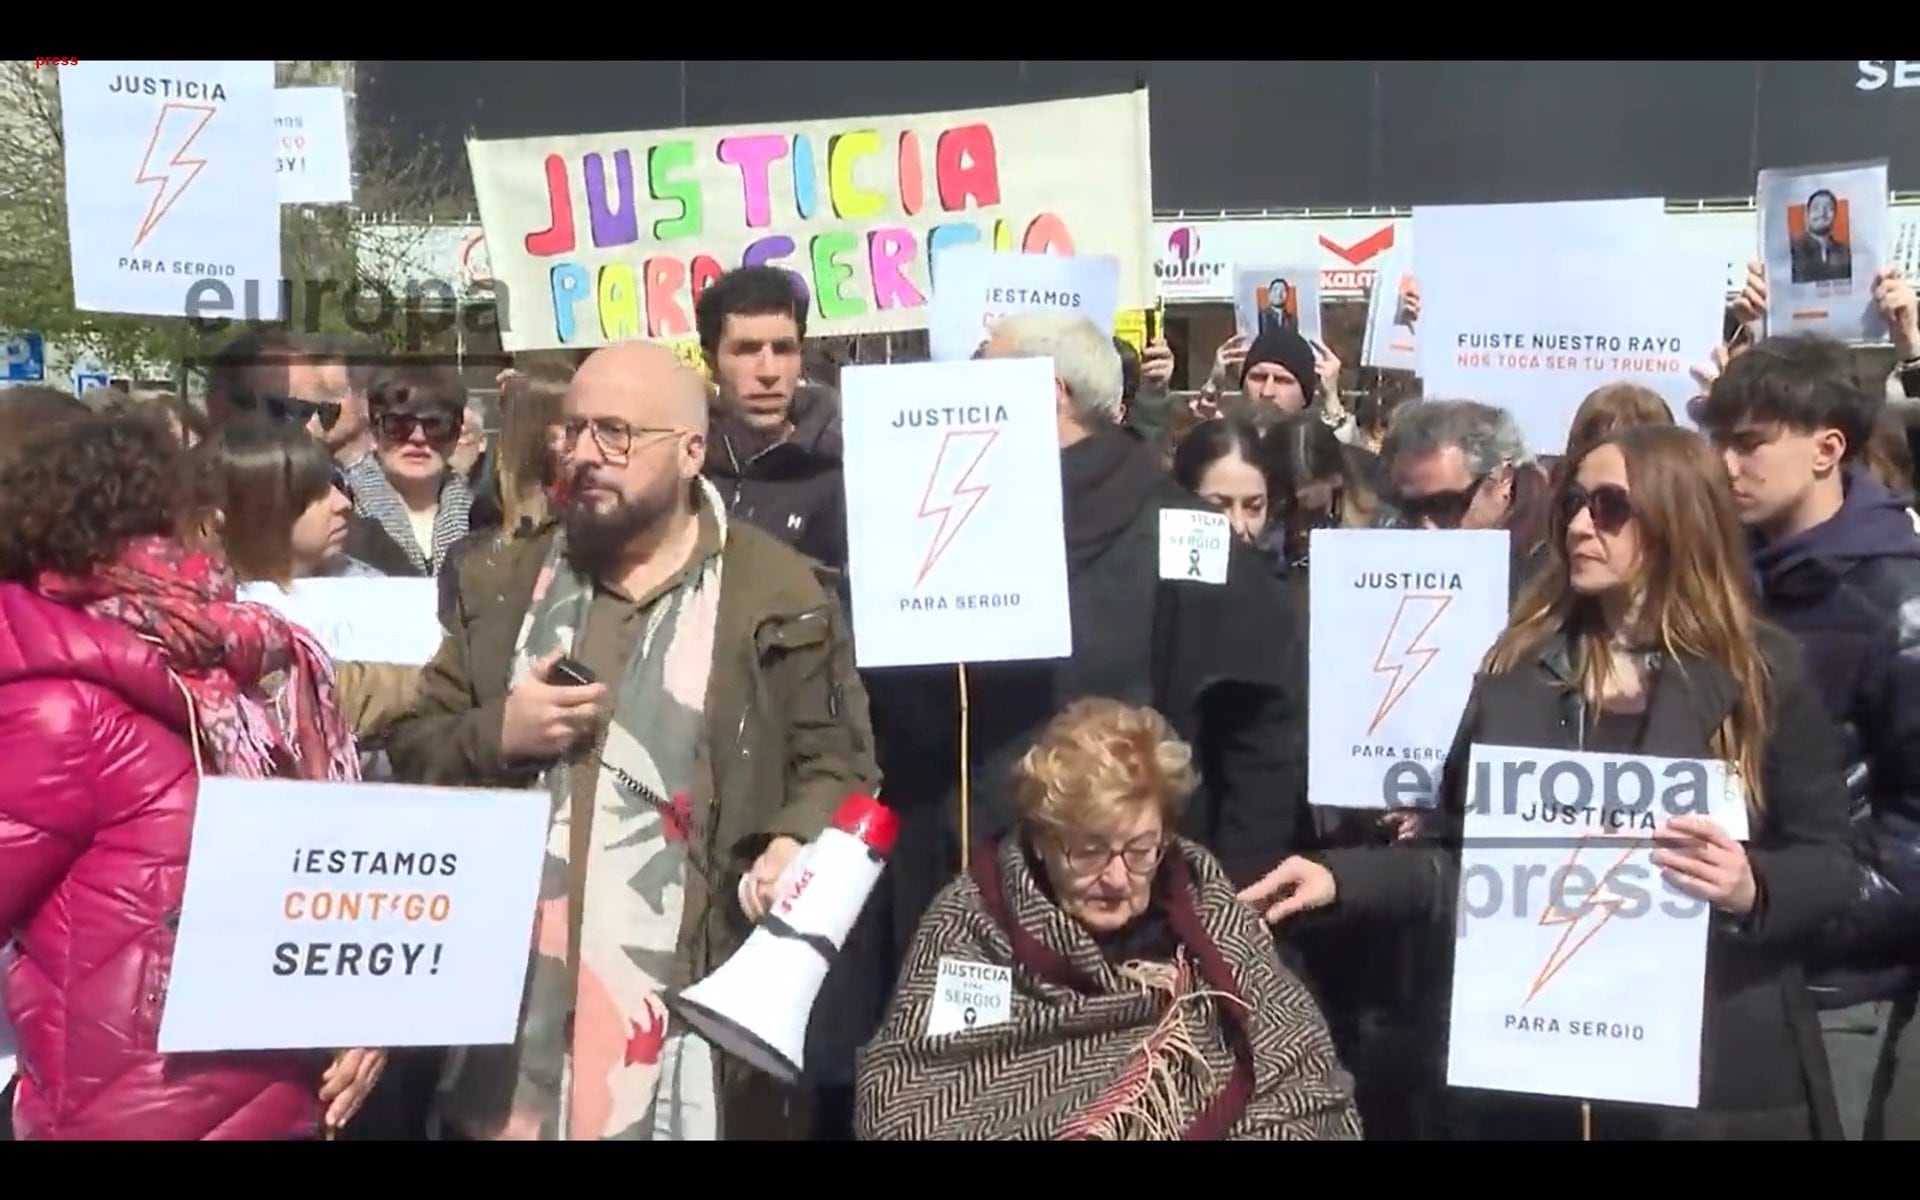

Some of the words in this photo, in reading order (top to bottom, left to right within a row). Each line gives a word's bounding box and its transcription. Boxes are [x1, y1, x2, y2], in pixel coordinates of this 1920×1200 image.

[109, 75, 227, 101] JUSTICIA
[525, 122, 1002, 257] JUSTICIA
[118, 257, 166, 274] PARA
[986, 288, 1081, 308] ¡ESTAMOS
[1458, 333, 1524, 349] FUISTE
[1532, 334, 1621, 351] NUESTRO
[1628, 336, 1681, 352] RAYO
[1457, 354, 1490, 367] NOS
[1498, 355, 1540, 369] TOCA
[1546, 356, 1577, 370] SER
[1585, 357, 1604, 371] TU
[1612, 357, 1680, 372] TRUENO
[892, 405, 1009, 428] JUSTICIA
[1354, 573, 1463, 589] JUSTICIA
[900, 597, 948, 612] PARA
[956, 593, 1021, 610] SERGIO
[1352, 745, 1396, 757] PARA
[1522, 803, 1656, 830] JUSTICIA
[292, 848, 457, 876] ¡ESTAMOS
[272, 942, 443, 976] SERGY!
[942, 963, 1009, 982] JUSTICIA
[945, 989, 1001, 1008] SERGIO
[1504, 1014, 1561, 1032] PARA
[1569, 1021, 1645, 1041] SERGIO
